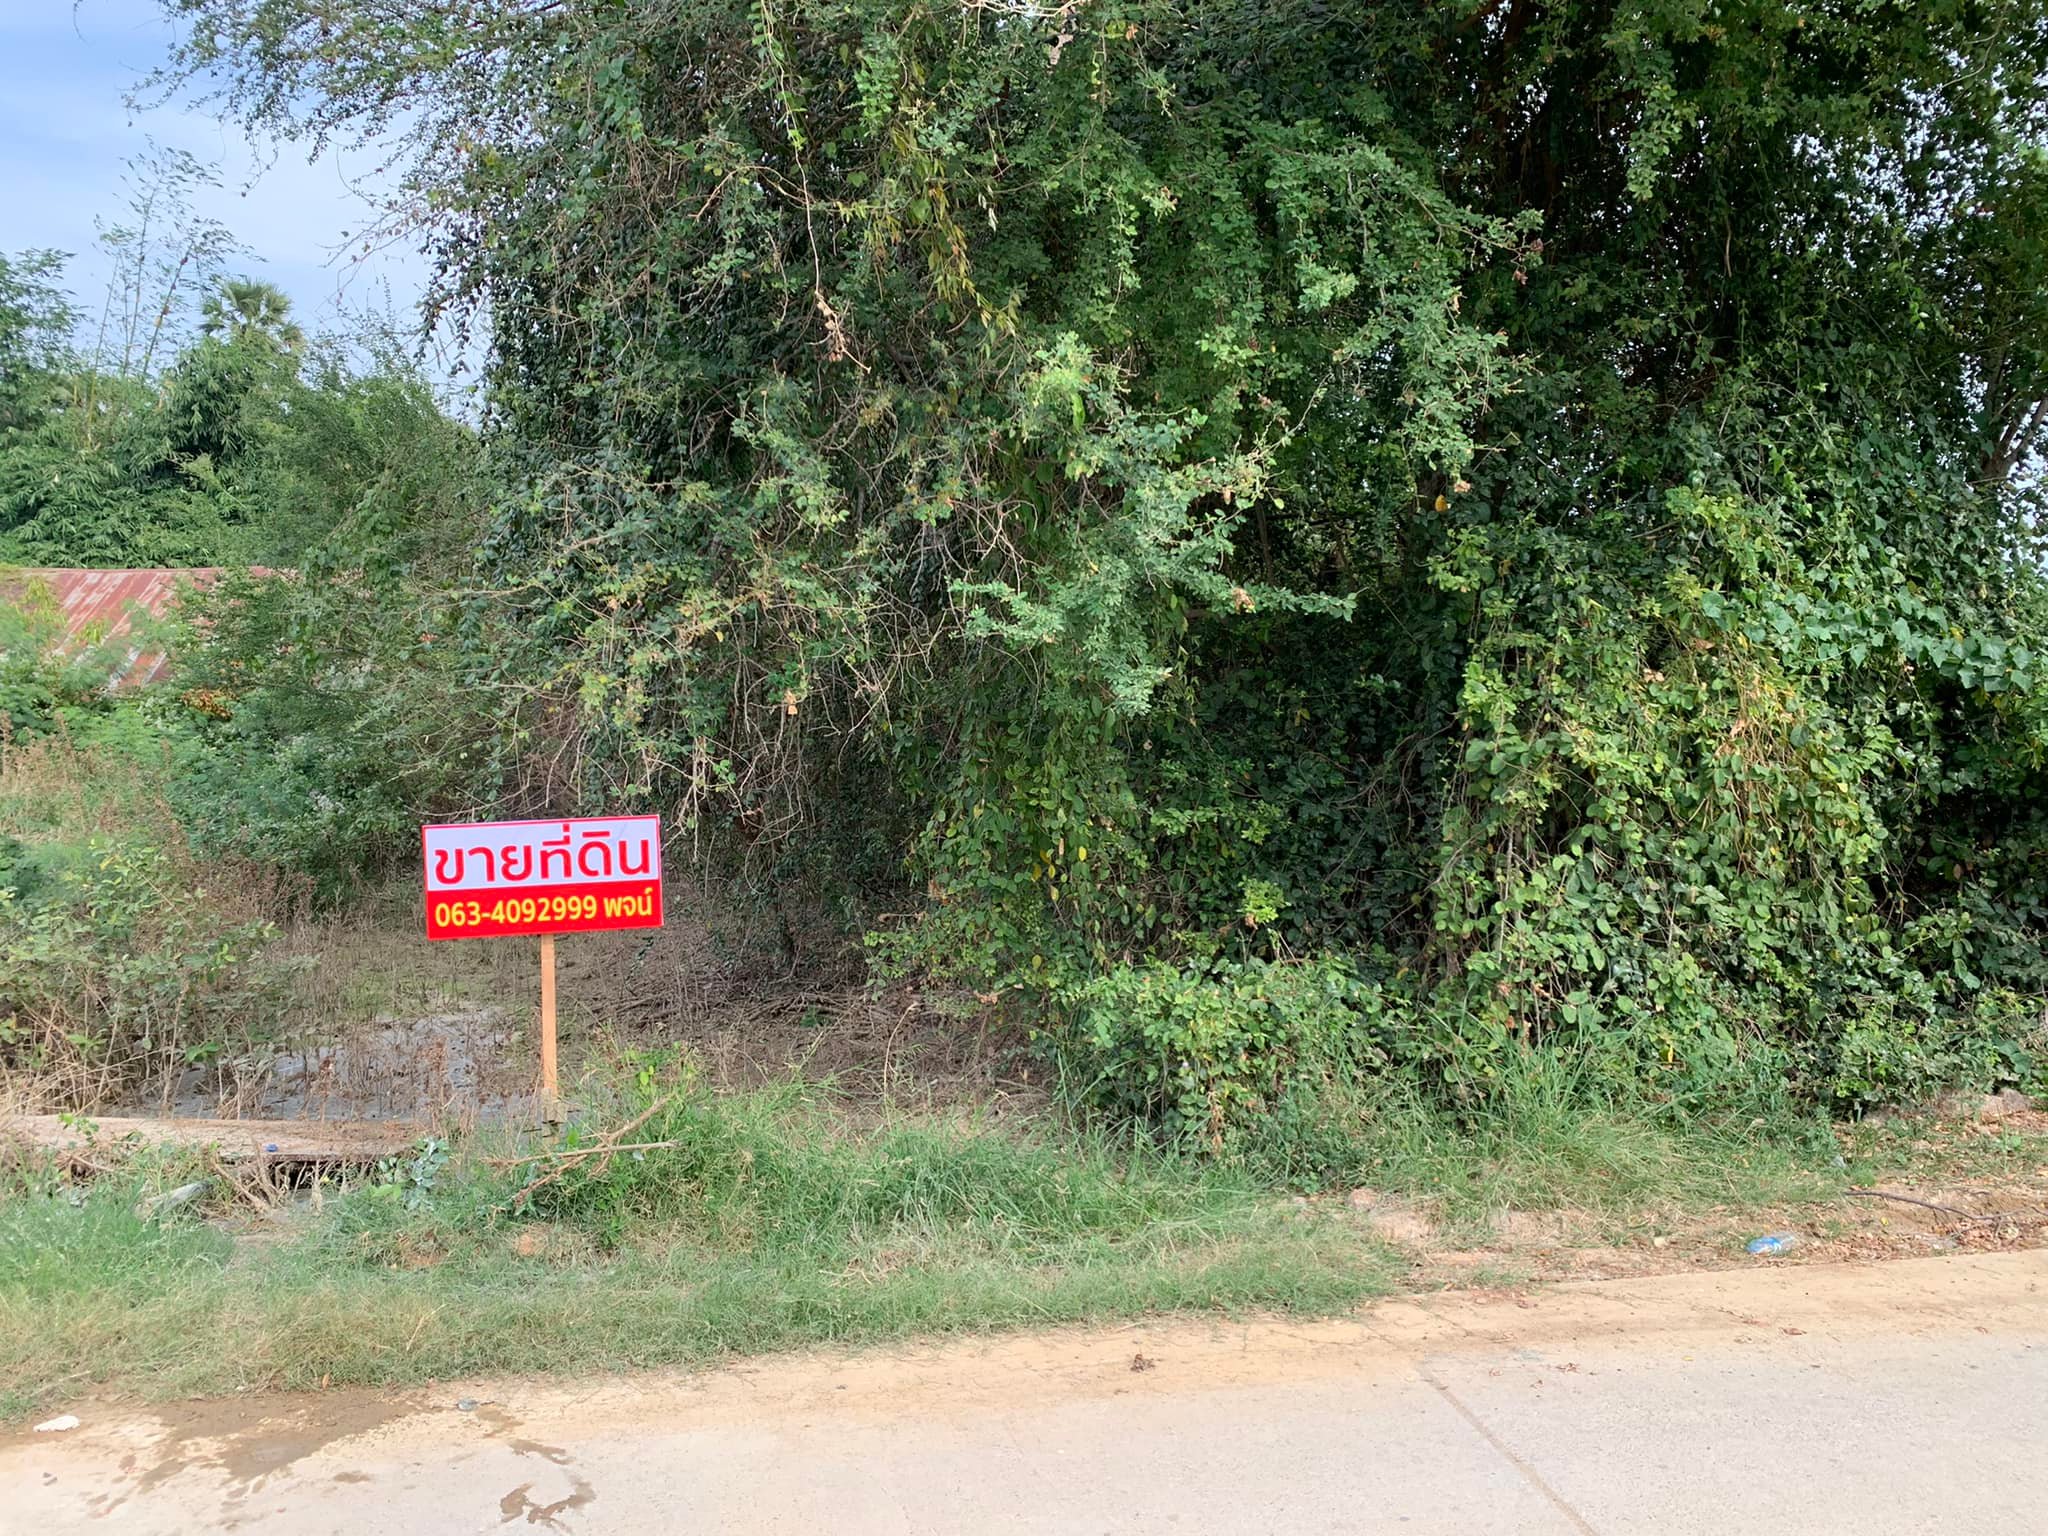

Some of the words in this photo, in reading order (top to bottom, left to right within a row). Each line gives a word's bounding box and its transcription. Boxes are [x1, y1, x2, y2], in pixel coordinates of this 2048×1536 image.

[434, 823, 650, 885] ขายที่ดิน
[435, 895, 597, 928] 063-4092999
[603, 887, 653, 918] พจน์
